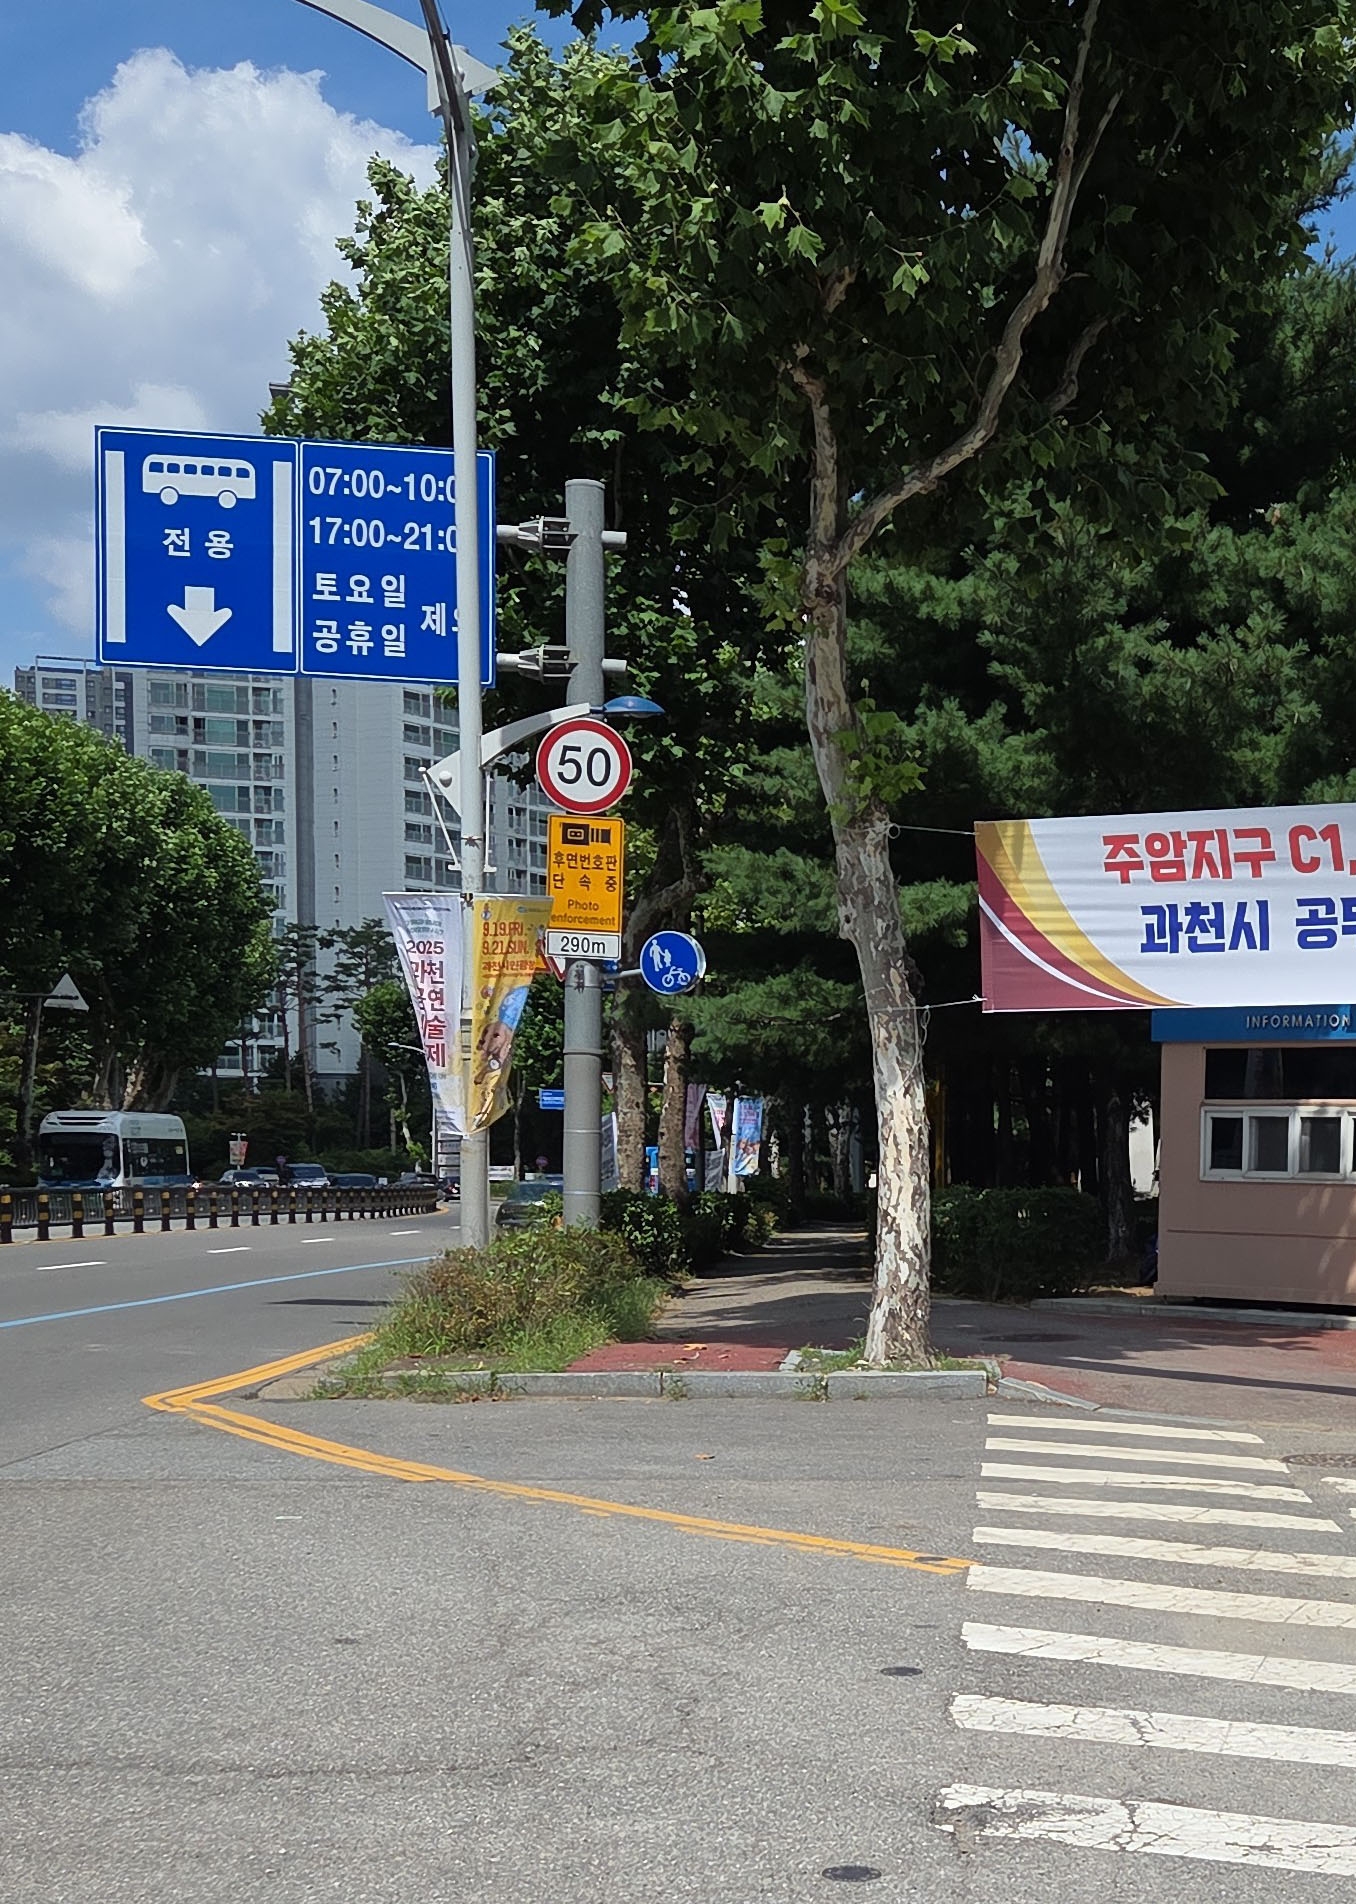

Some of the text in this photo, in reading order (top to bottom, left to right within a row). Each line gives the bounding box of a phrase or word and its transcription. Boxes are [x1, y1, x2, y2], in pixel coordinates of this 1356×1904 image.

[308, 466, 457, 503] 07:00~10:0
[308, 516, 457, 553] 17:00~21:0
[312, 572, 406, 608] 토요일
[420, 602, 460, 637] 제
[312, 619, 406, 658] 공휴일
[557, 744, 612, 787] 50
[552, 850, 618, 872] 후면번호판
[1103, 828, 1276, 884] 주암지구
[550, 912, 616, 927] enforcement
[567, 898, 600, 911] Photo
[1140, 900, 1270, 954] 과천시
[406, 940, 445, 955] 2025
[560, 935, 606, 955] 290m
[1245, 1013, 1352, 1029] INFORMATION
